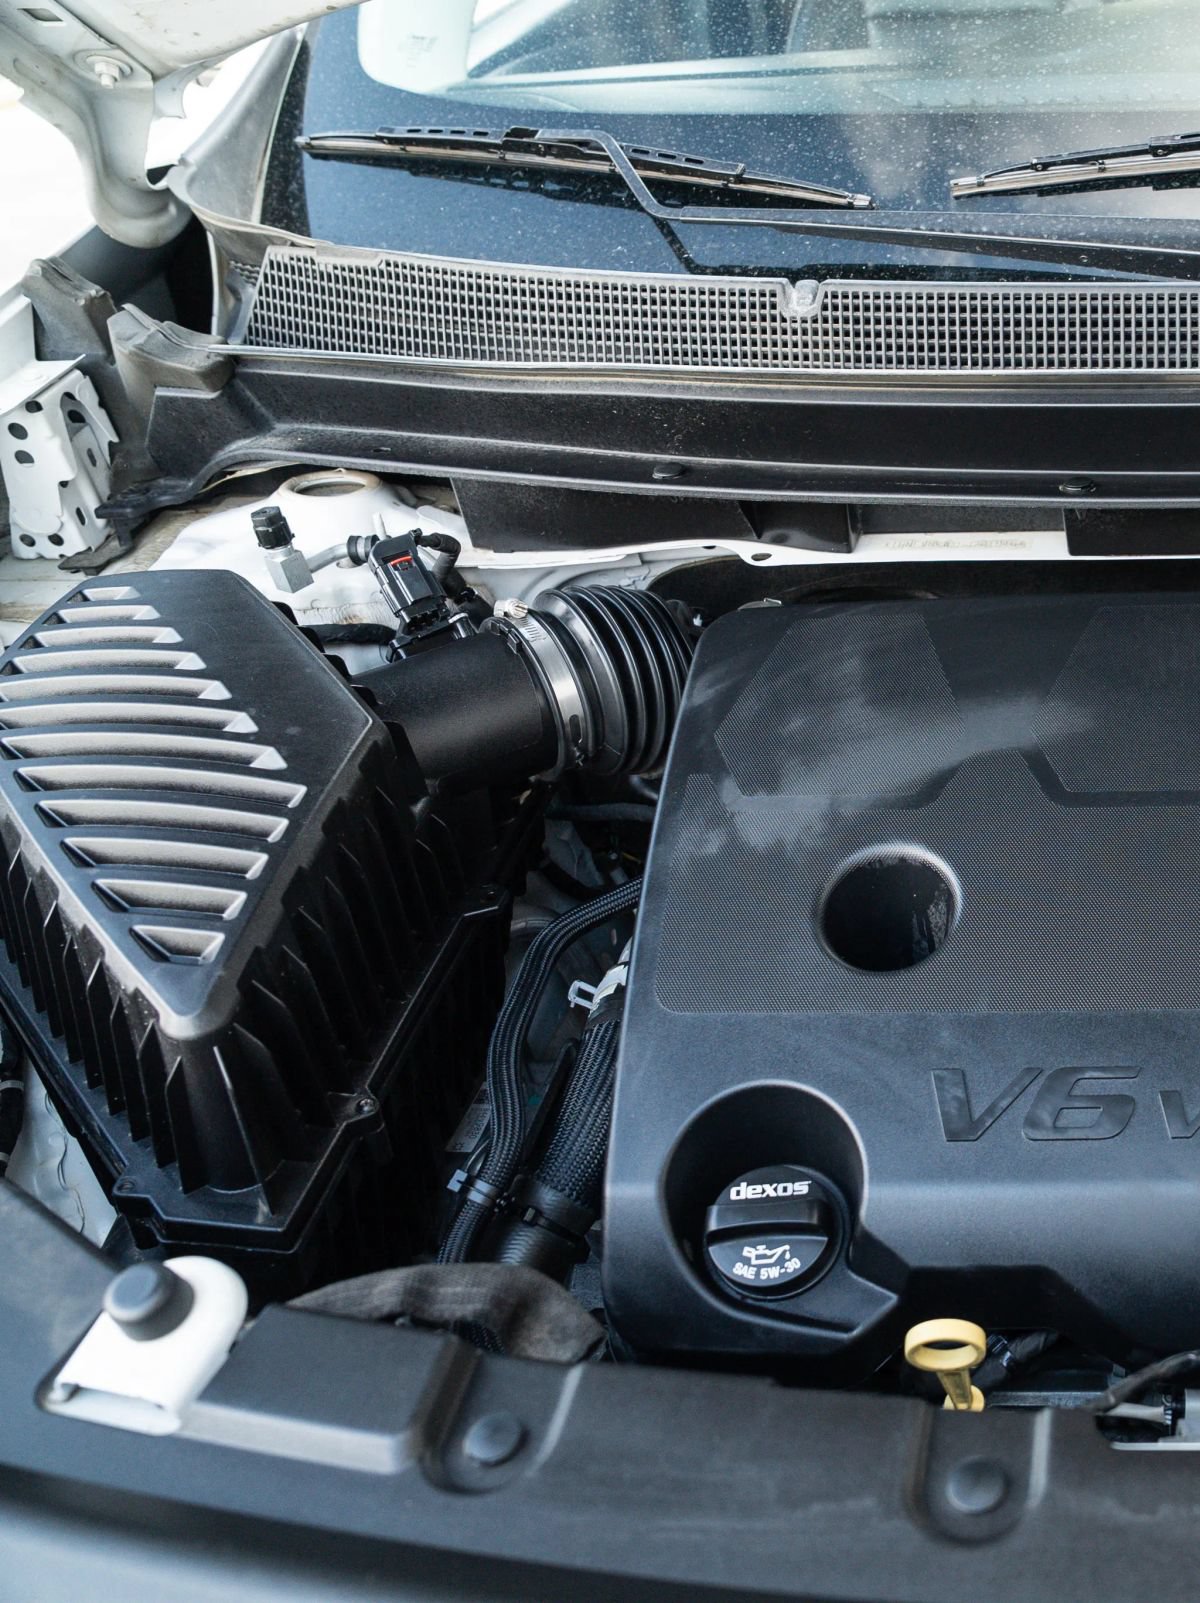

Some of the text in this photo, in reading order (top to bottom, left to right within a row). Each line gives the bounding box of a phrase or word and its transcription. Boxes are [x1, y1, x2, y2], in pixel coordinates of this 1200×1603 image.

[931, 1066, 1142, 1142] V6
[730, 1180, 811, 1200] dexos
[733, 1257, 801, 1280] SAE 5W-30
